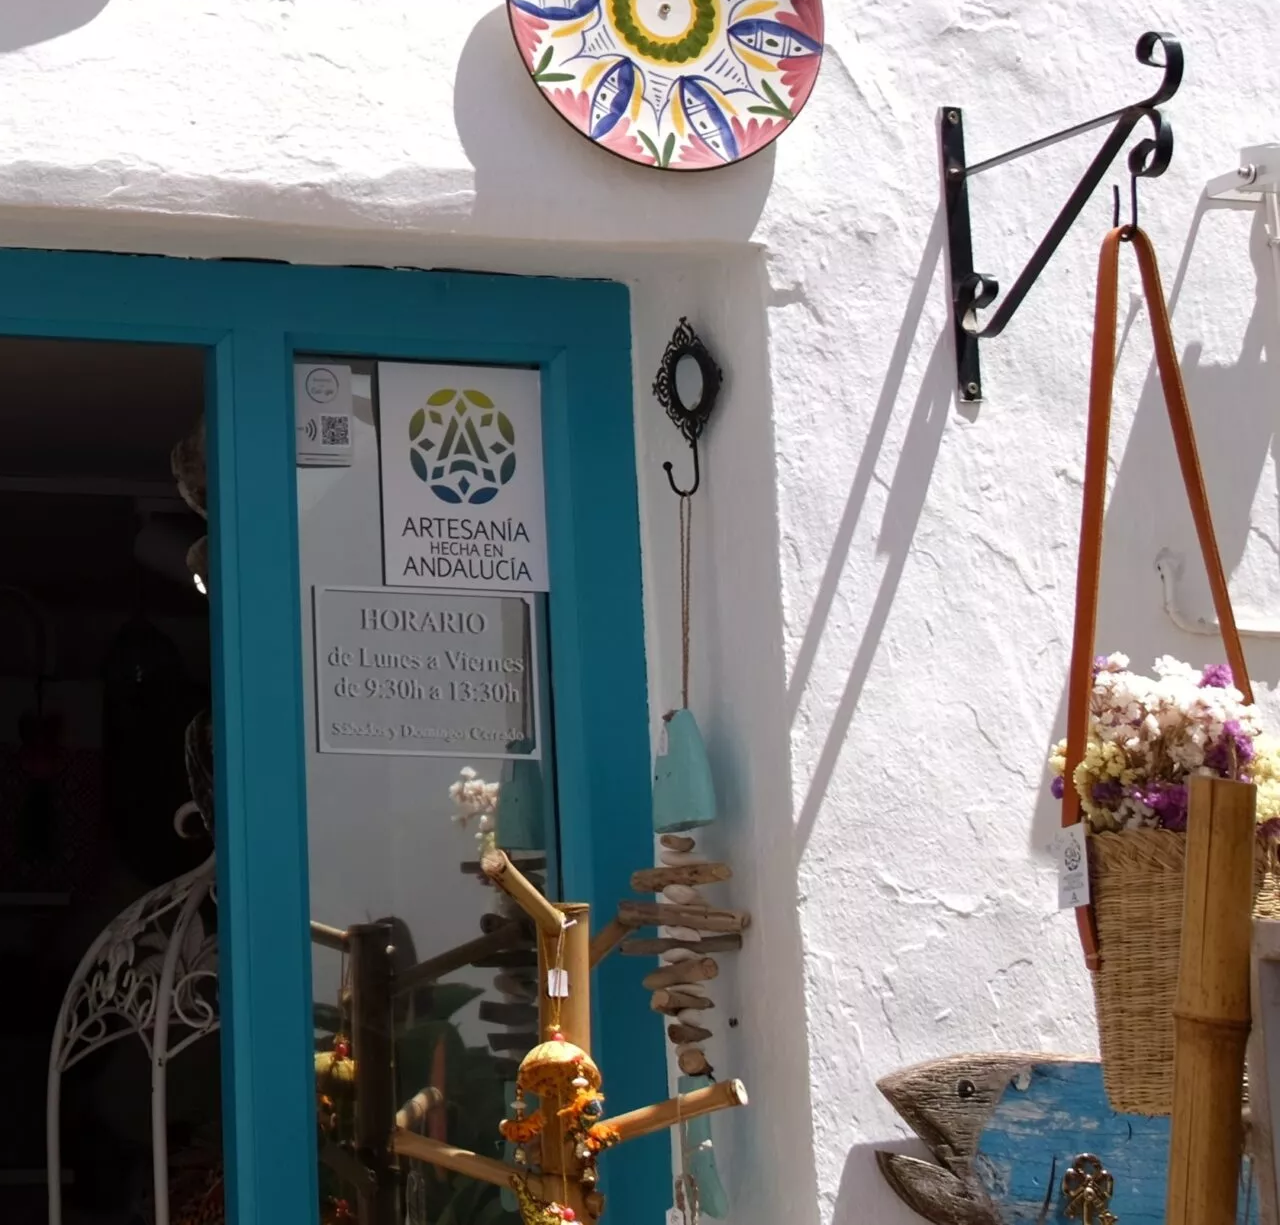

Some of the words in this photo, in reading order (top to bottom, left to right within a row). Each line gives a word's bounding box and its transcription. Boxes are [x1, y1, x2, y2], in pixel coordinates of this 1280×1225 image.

[402, 516, 530, 543] ARTESANÍA
[430, 541, 480, 556] HECHA
[484, 543, 503, 557] EN
[403, 555, 533, 582] ANDALUCÍA
[359, 608, 488, 634] HORARIO
[327, 646, 353, 667] de
[359, 647, 422, 670] Lunes
[426, 656, 440, 671] a
[445, 650, 525, 673] Viernes
[334, 677, 360, 698] de
[364, 679, 424, 700] 9:30h
[429, 686, 442, 701] a
[449, 680, 520, 704] 13:30h
